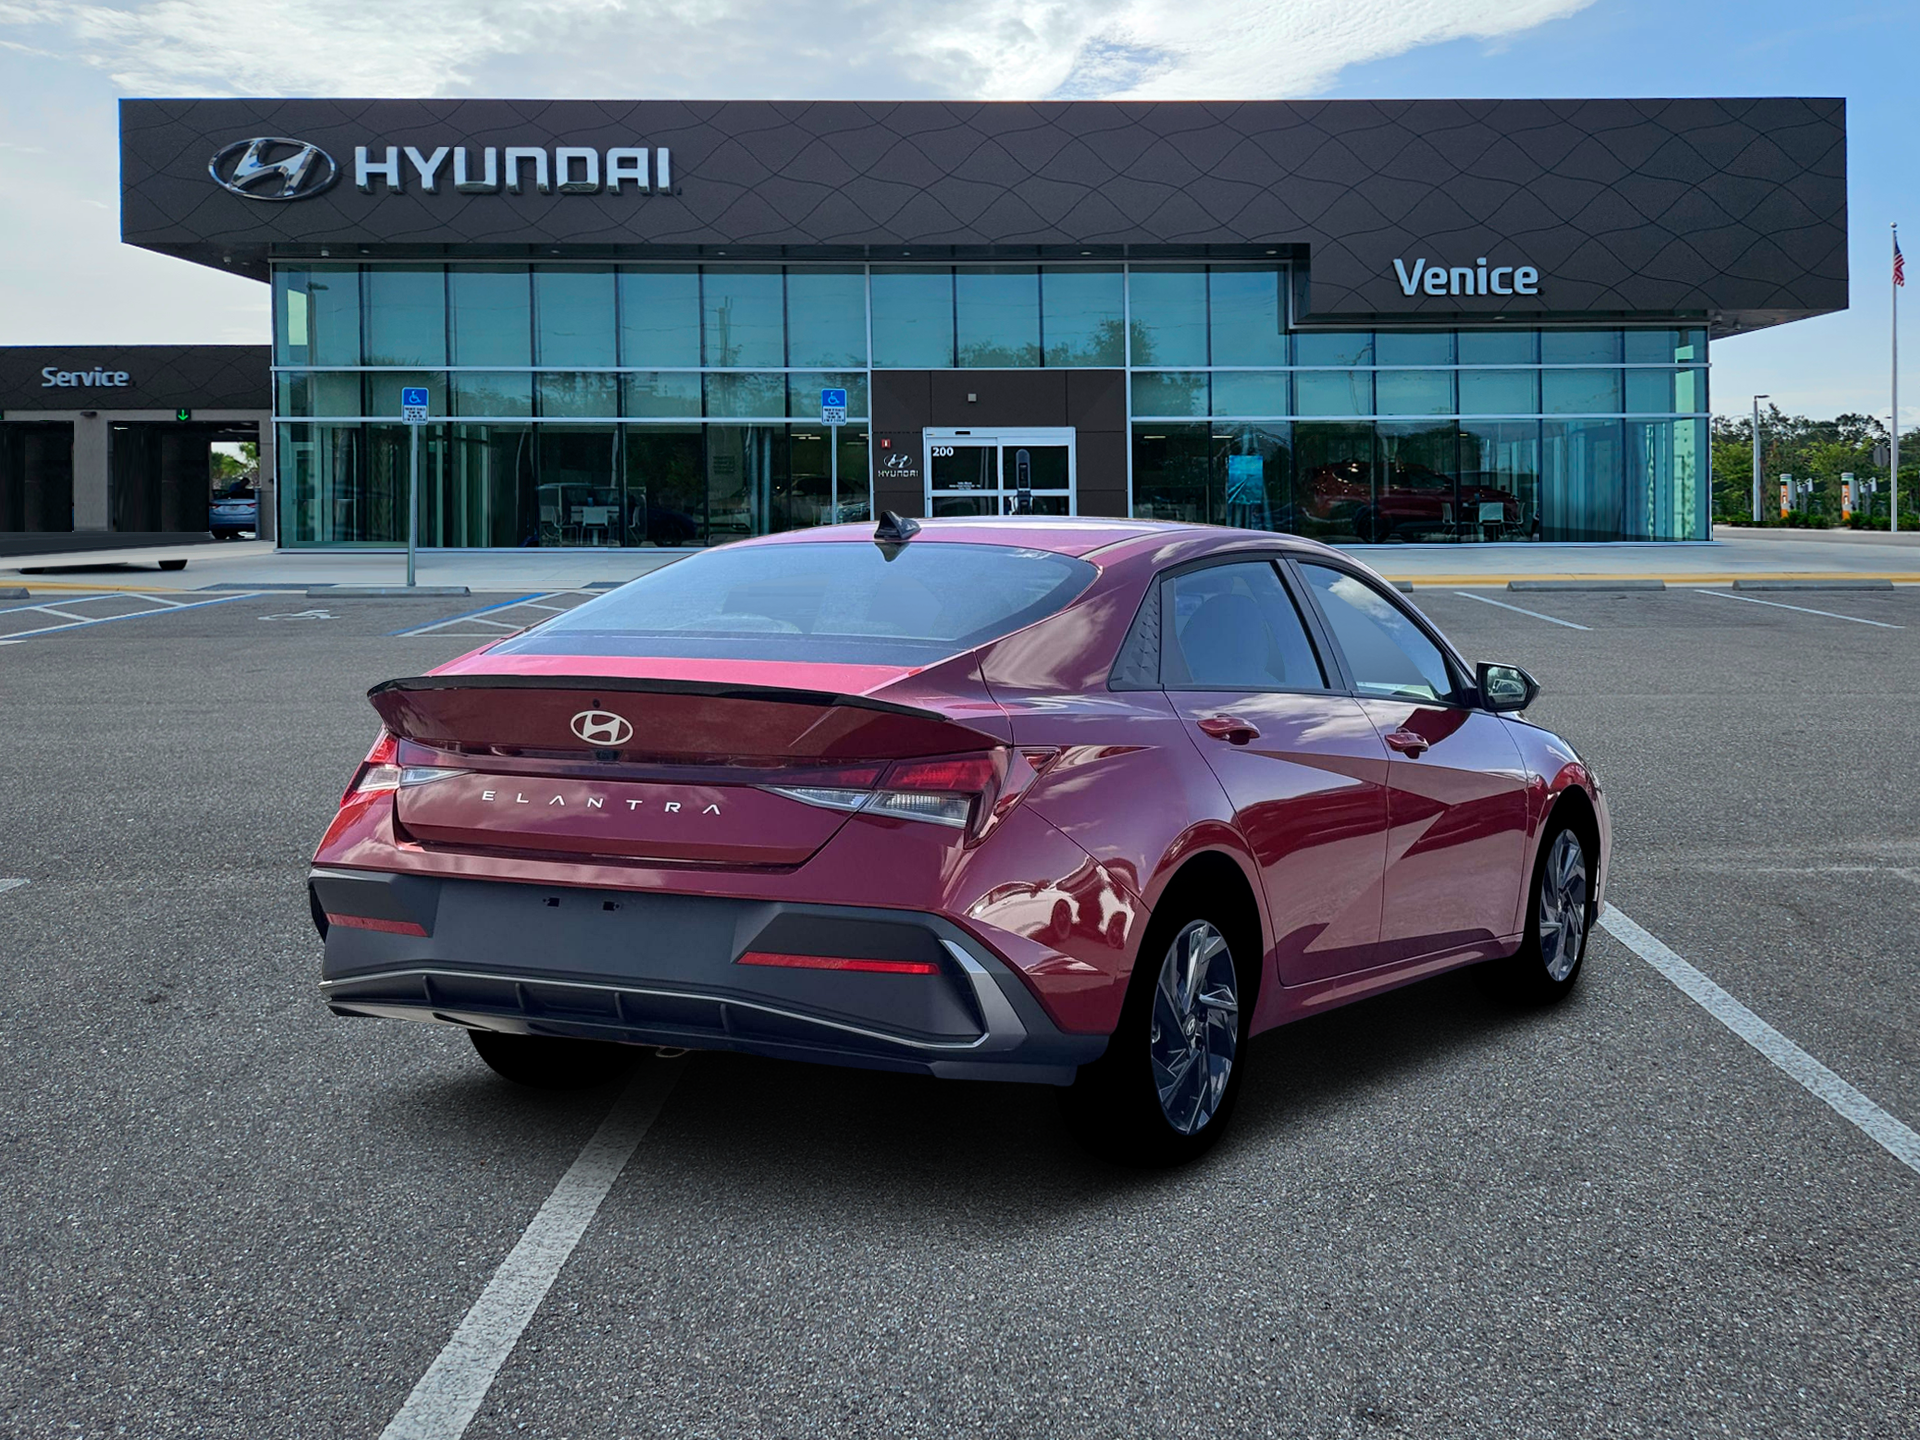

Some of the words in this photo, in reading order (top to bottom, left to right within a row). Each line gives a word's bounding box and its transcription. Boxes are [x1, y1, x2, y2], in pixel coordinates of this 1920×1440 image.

[354, 146, 672, 193] HYUNDAI
[1393, 257, 1539, 296] Venice
[41, 366, 130, 387] Service
[932, 447, 954, 457] 200
[877, 470, 919, 478] HYUNDAI
[482, 790, 721, 816] ELANTRA
